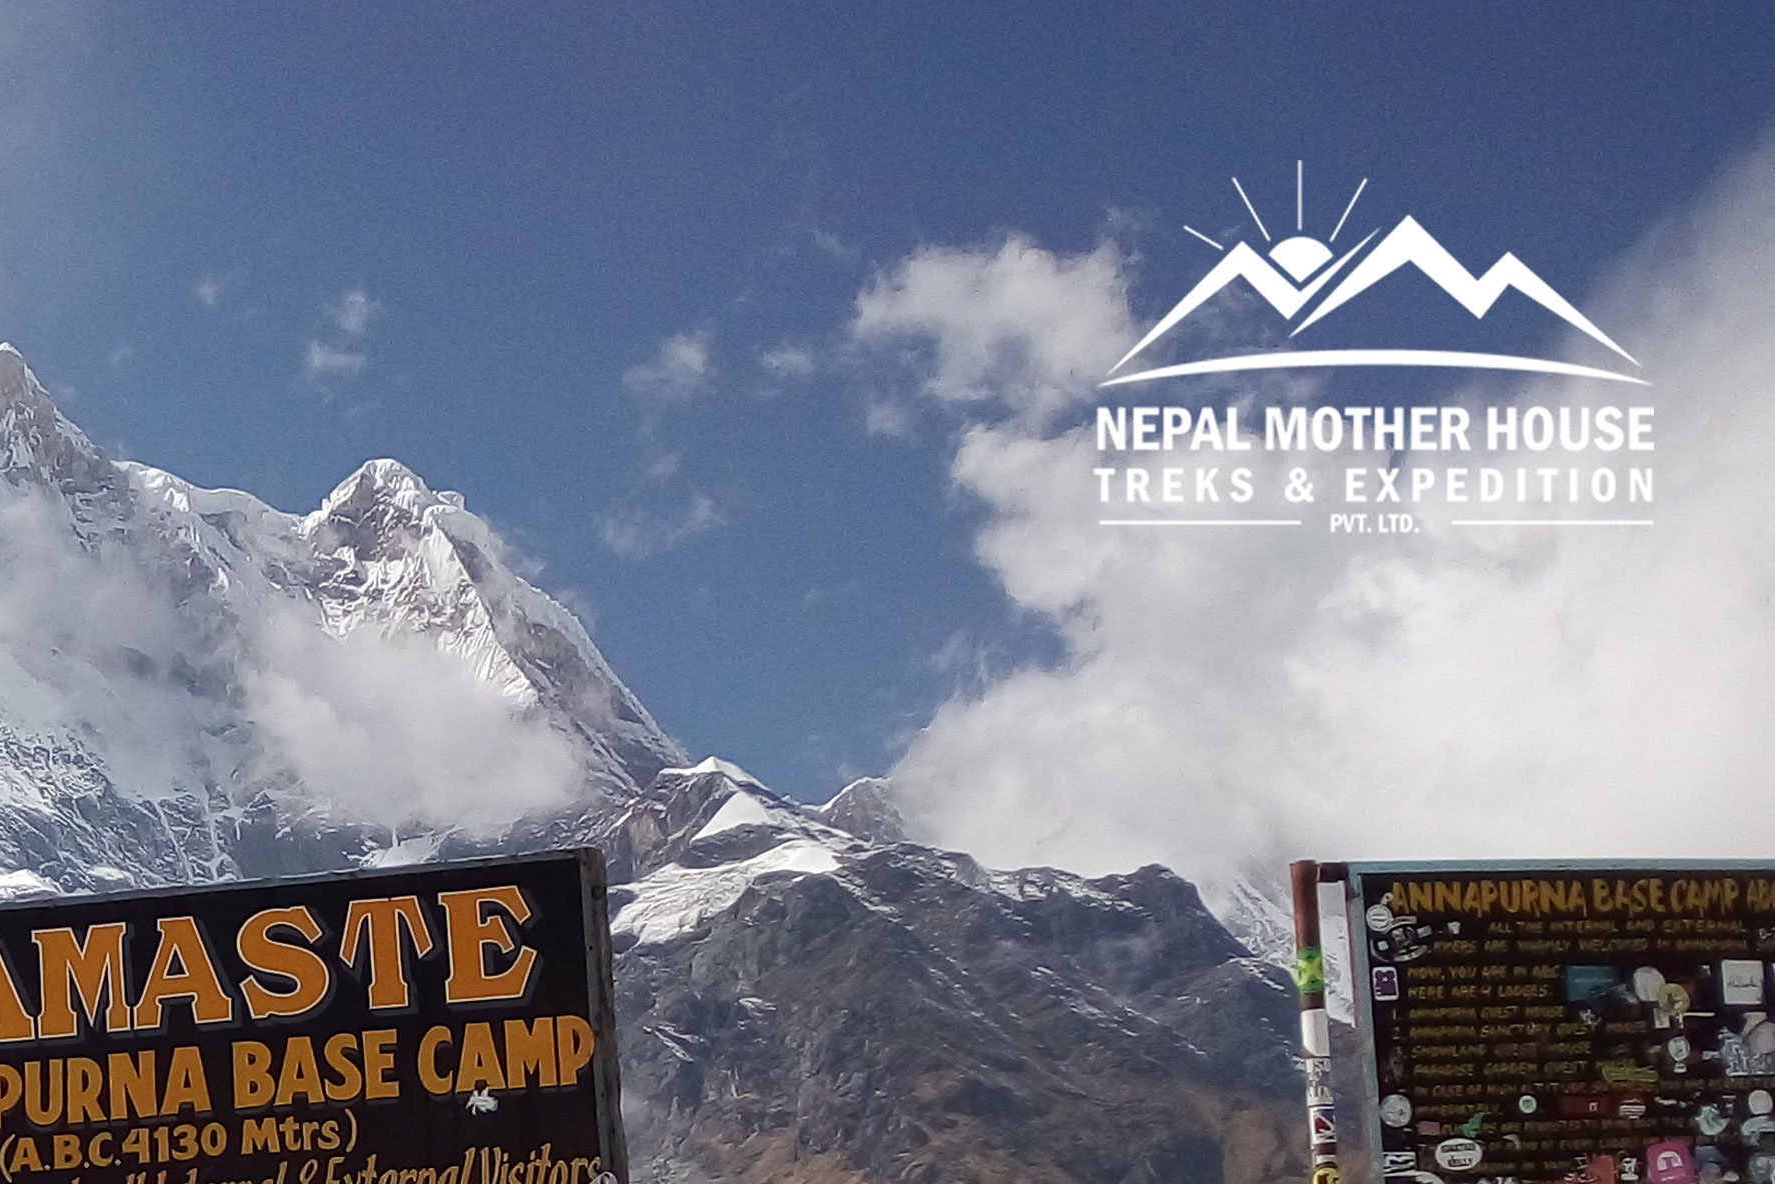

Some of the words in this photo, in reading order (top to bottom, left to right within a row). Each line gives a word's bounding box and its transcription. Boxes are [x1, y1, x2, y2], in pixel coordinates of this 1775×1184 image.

[1391, 880, 1587, 914] ANNAPURNA
[1592, 878, 1666, 913] BASE
[1670, 878, 1739, 913] CAMP
[1746, 879, 1775, 912] AB
[232, 1028, 400, 1111] BASE
[416, 1014, 596, 1096] CAMP
[241, 1108, 358, 1156] Mtrs)
